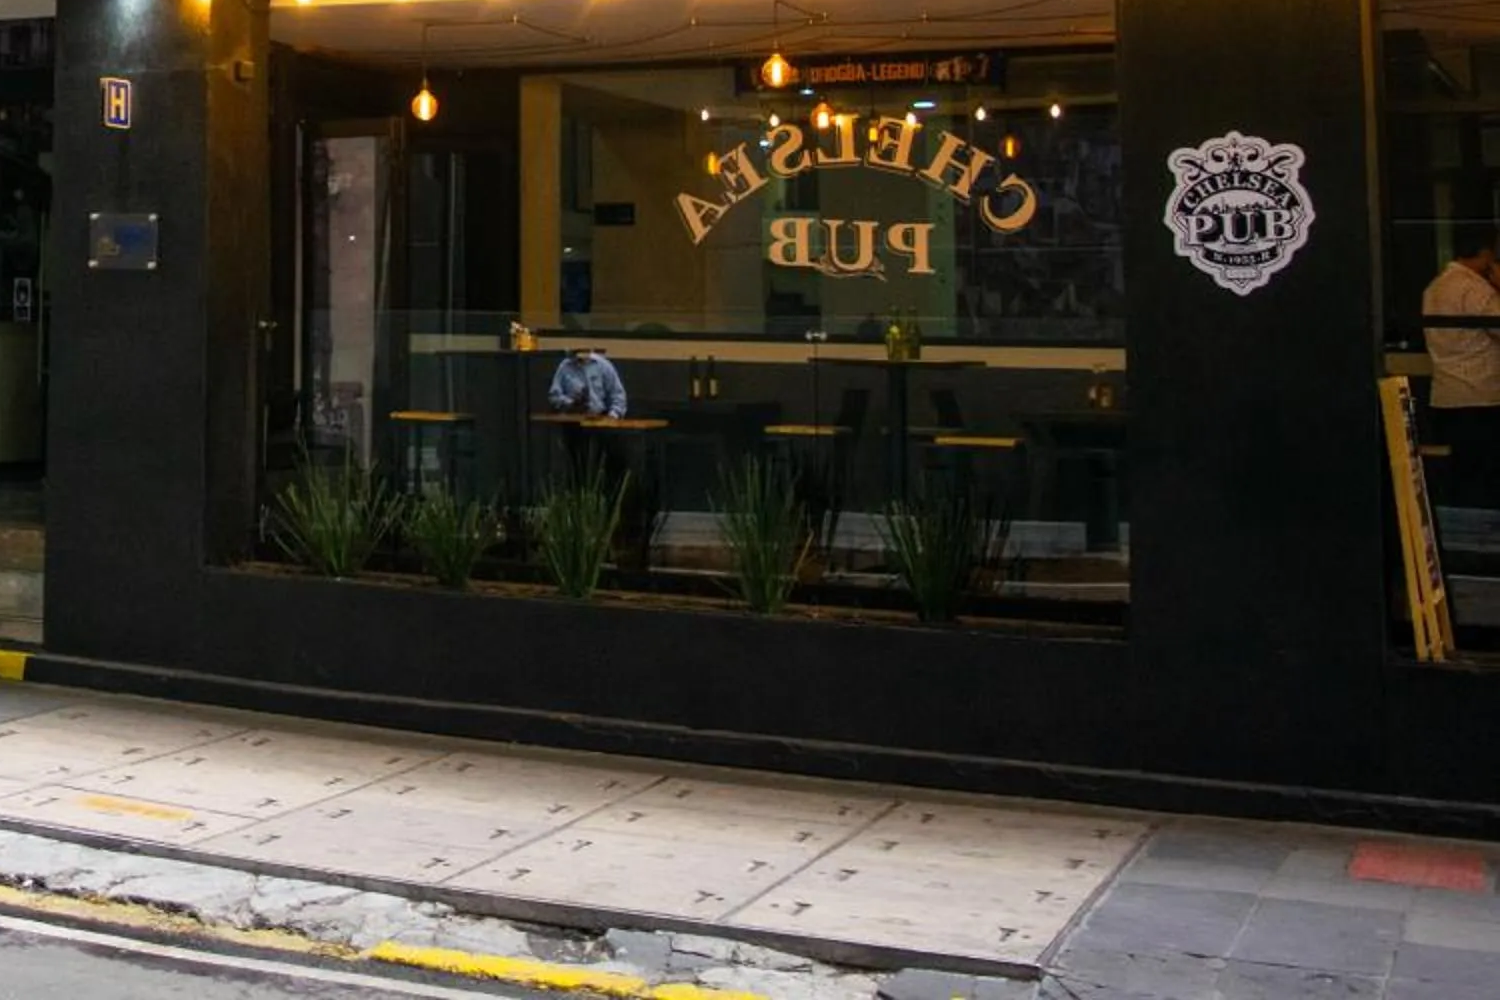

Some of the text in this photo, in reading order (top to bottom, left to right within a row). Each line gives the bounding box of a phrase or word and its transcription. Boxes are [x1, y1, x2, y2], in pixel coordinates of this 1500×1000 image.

[110, 85, 126, 121] H
[1182, 171, 1292, 210] CHELSEA
[1185, 208, 1297, 245] PUB
